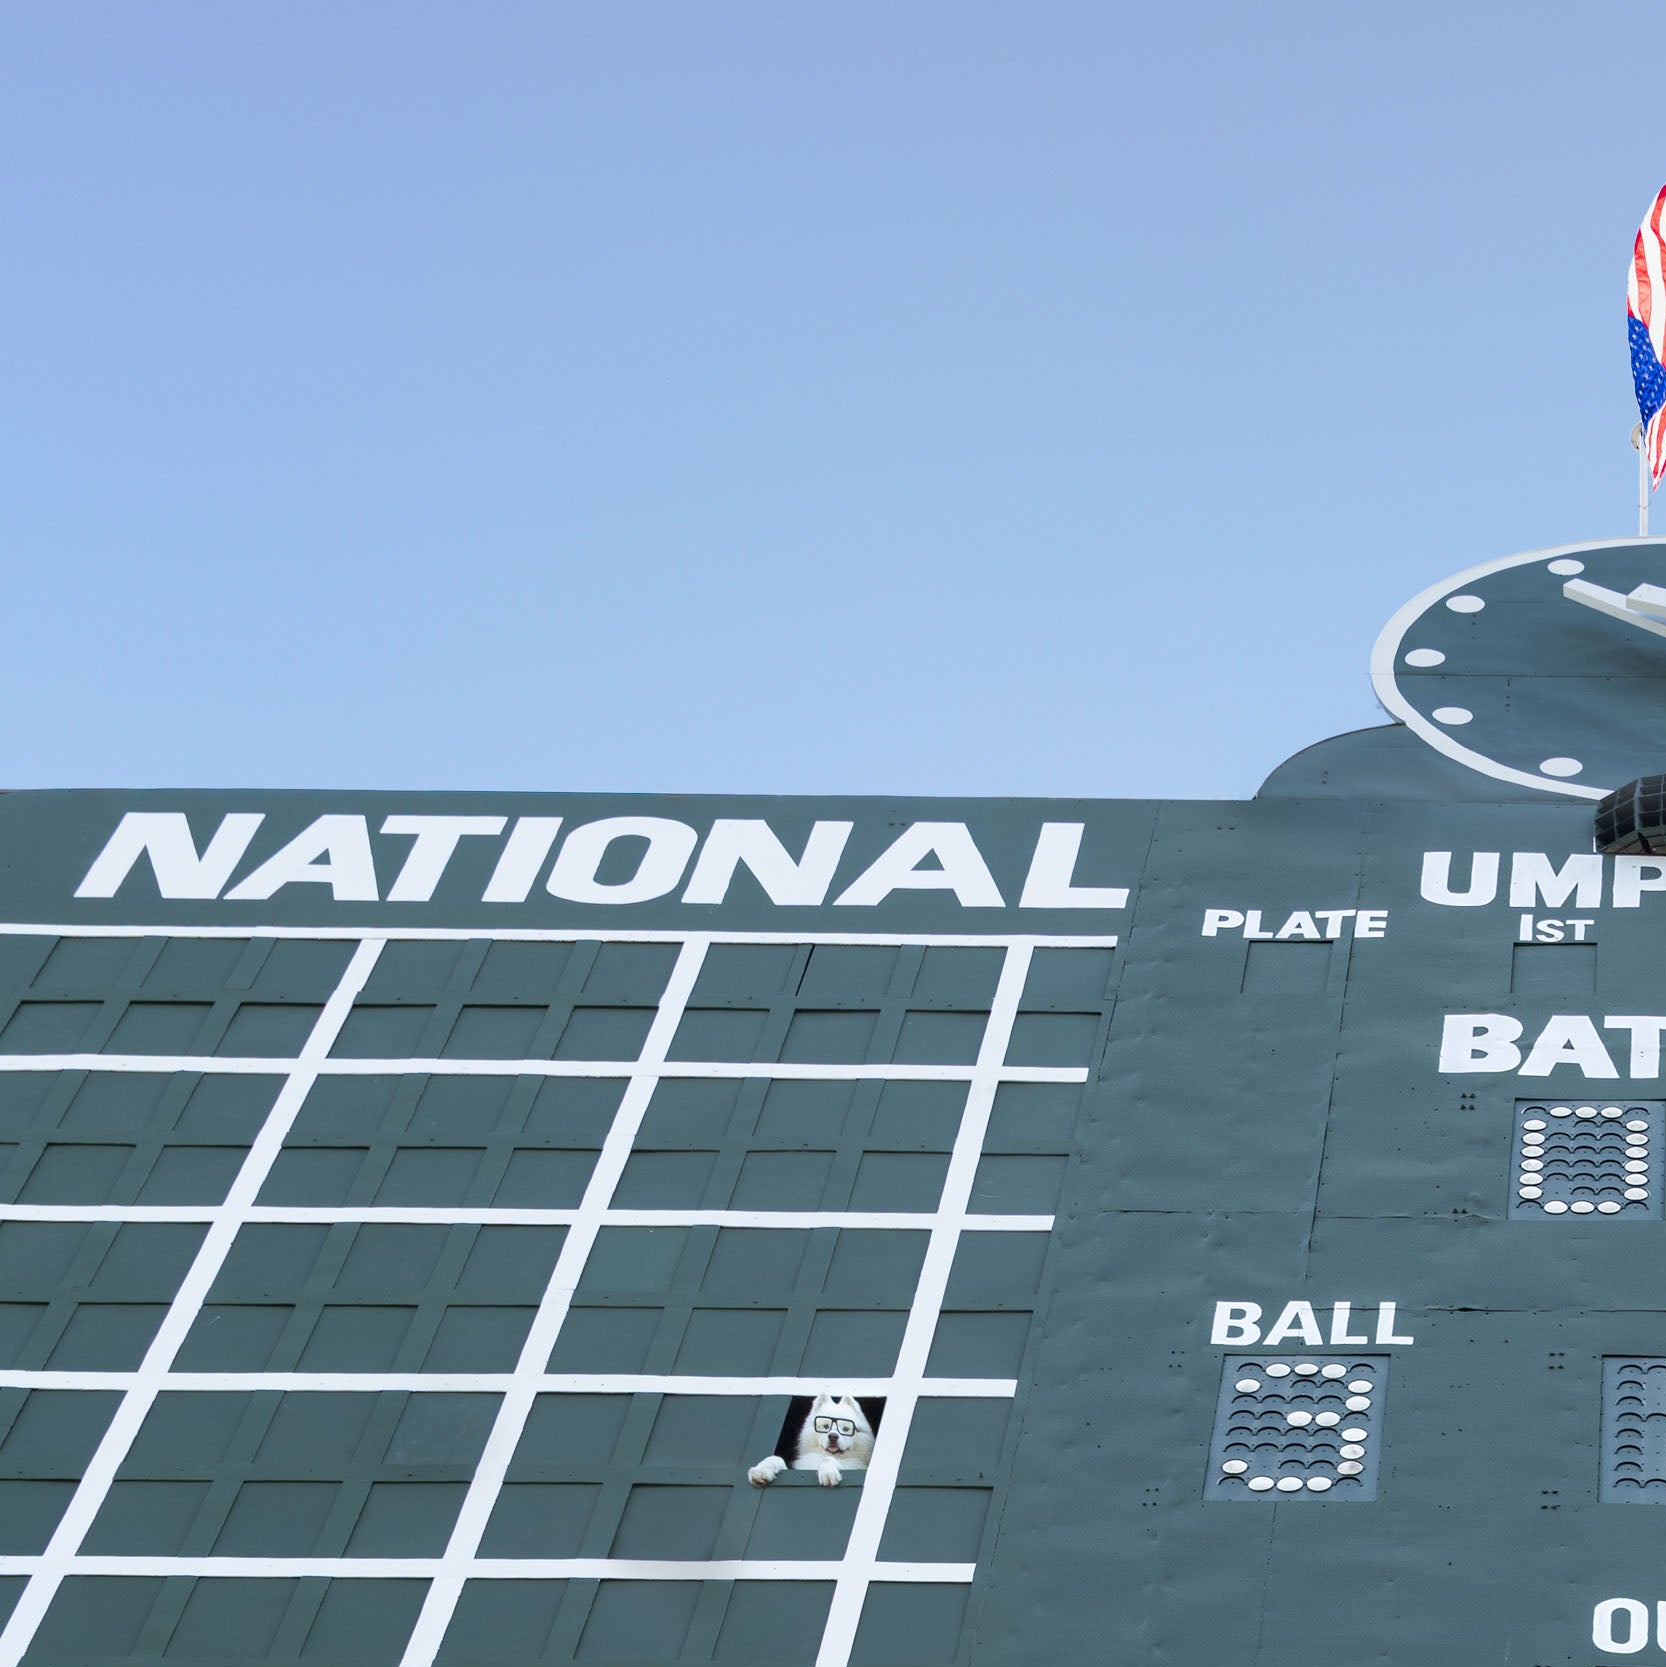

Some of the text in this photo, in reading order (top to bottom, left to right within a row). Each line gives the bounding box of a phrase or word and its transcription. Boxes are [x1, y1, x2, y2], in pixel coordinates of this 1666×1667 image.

[73, 813, 1130, 908] NATIONAL
[1202, 909, 1388, 938] PLATE
[1520, 914, 1594, 942] 1ST
[1211, 1301, 1413, 1345] BALL
